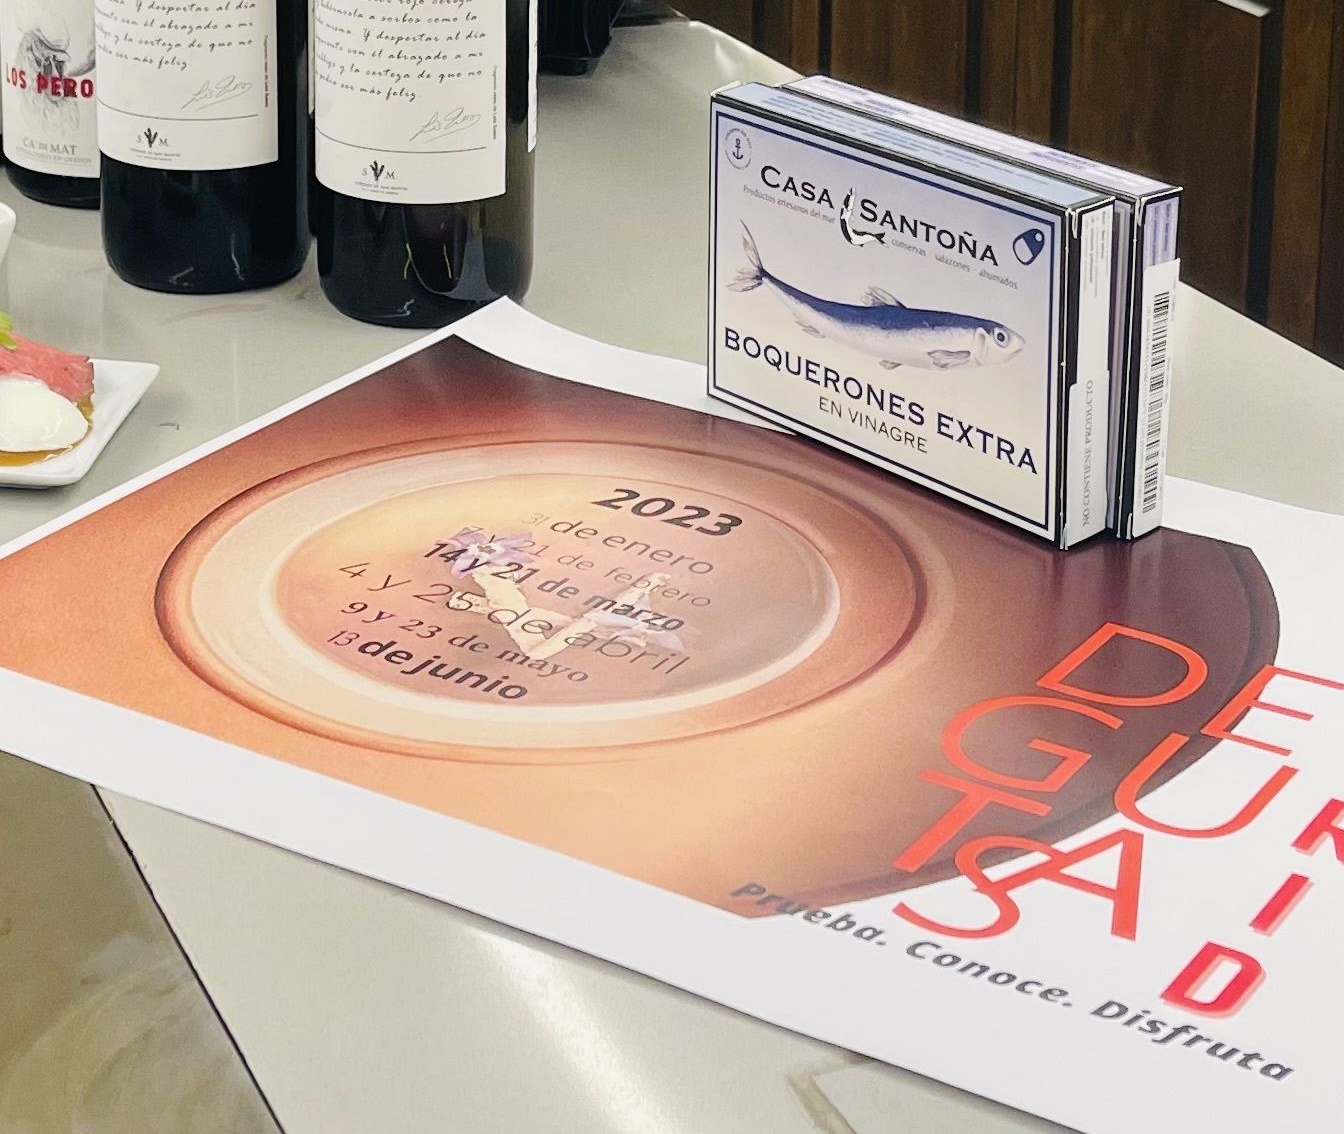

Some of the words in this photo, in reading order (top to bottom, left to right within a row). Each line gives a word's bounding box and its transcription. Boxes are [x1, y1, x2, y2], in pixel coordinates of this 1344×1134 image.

[6, 62, 27, 90] LOS
[36, 72, 94, 99] PERO
[760, 165, 835, 210] CASA
[859, 198, 999, 266] SANTOÑA
[724, 326, 926, 426] BOQUERONES
[936, 412, 1039, 475] EXTRA
[818, 396, 843, 418] EN
[848, 406, 928, 454] VINAGRE
[550, 520, 598, 540] de
[602, 533, 714, 575] enero
[590, 487, 744, 537] 2023
[338, 561, 372, 579] 4
[366, 574, 412, 592] y
[412, 582, 488, 612] 25
[487, 608, 554, 635] de
[564, 632, 691, 675] abril
[424, 542, 468, 563] 14
[459, 557, 492, 574] y
[490, 561, 540, 585] 21
[537, 577, 580, 600] de
[583, 594, 686, 632] marzo
[557, 554, 595, 571] de
[604, 566, 712, 608] febrero
[326, 629, 360, 647] 13
[357, 639, 414, 666] de
[399, 654, 529, 700] junio
[340, 601, 369, 615] 9
[361, 609, 398, 624] y
[398, 618, 443, 640] 23
[447, 634, 490, 654] de
[495, 649, 590, 683] mayo
[729, 880, 888, 949] Prueba.
[905, 938, 1074, 1008] Conoce.
[1089, 997, 1298, 1083] Disfruta
